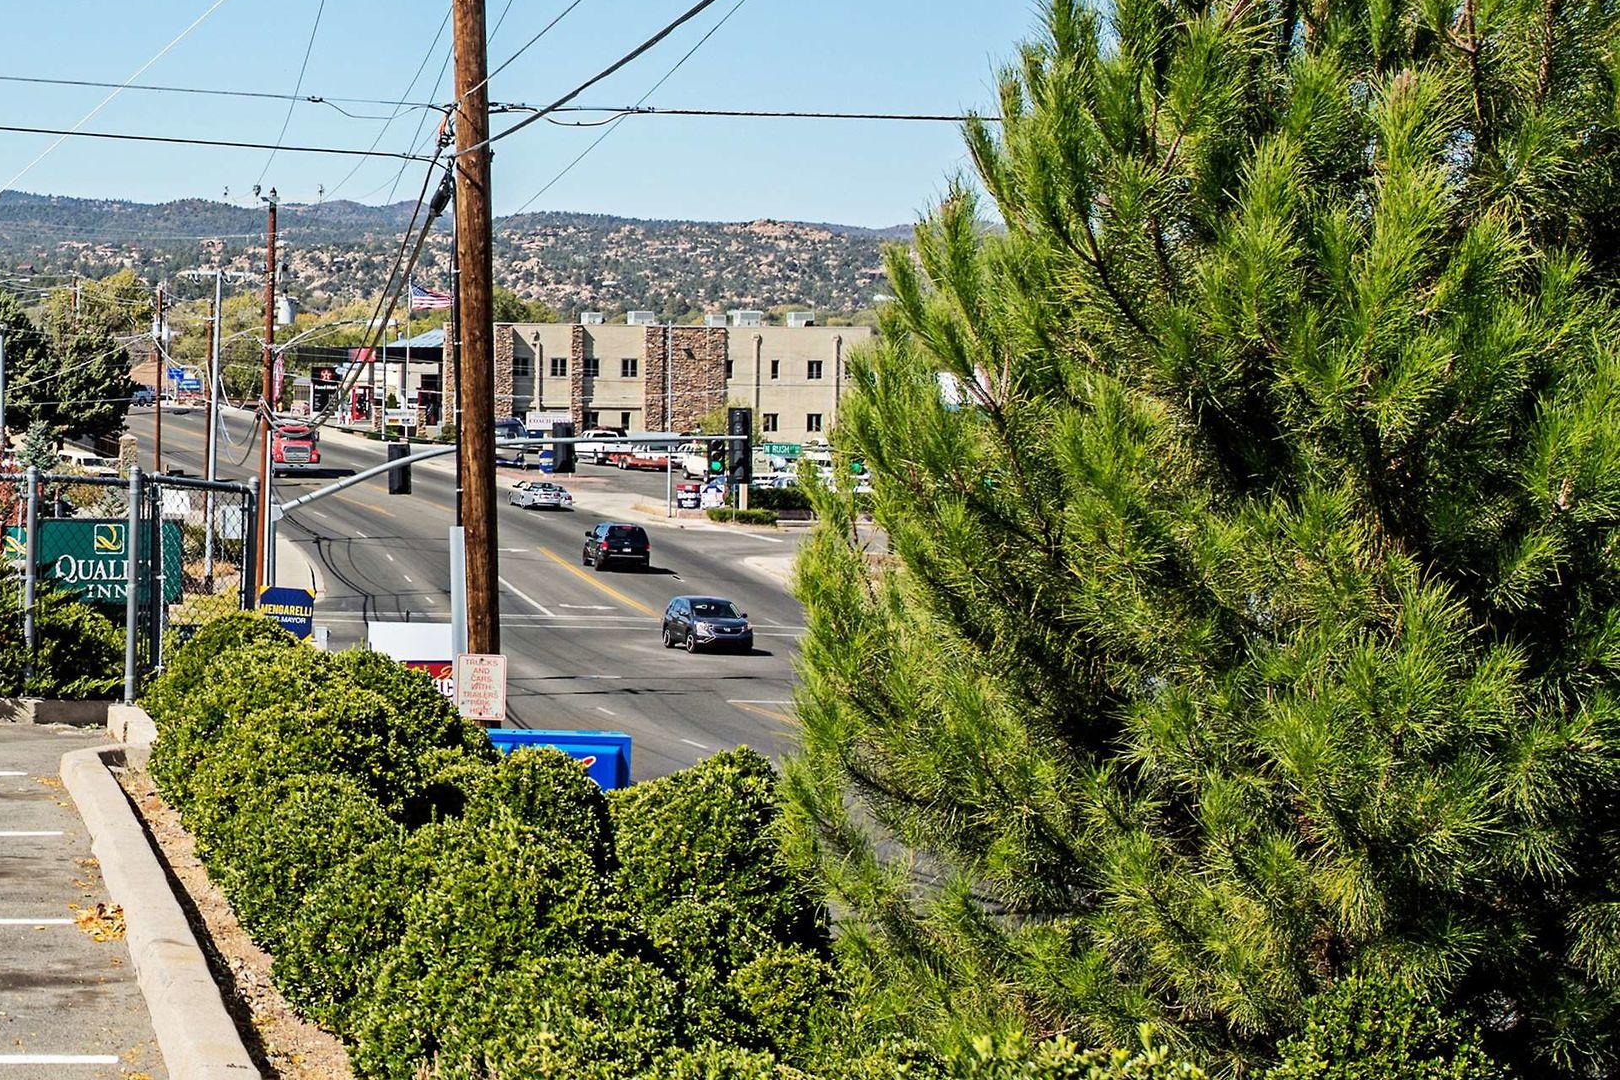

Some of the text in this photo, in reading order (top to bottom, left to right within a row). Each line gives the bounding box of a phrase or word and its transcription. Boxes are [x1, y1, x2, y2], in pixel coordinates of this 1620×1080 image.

[55, 554, 151, 583] QUALI
[87, 584, 128, 598] INN
[281, 616, 306, 624] MAYOR
